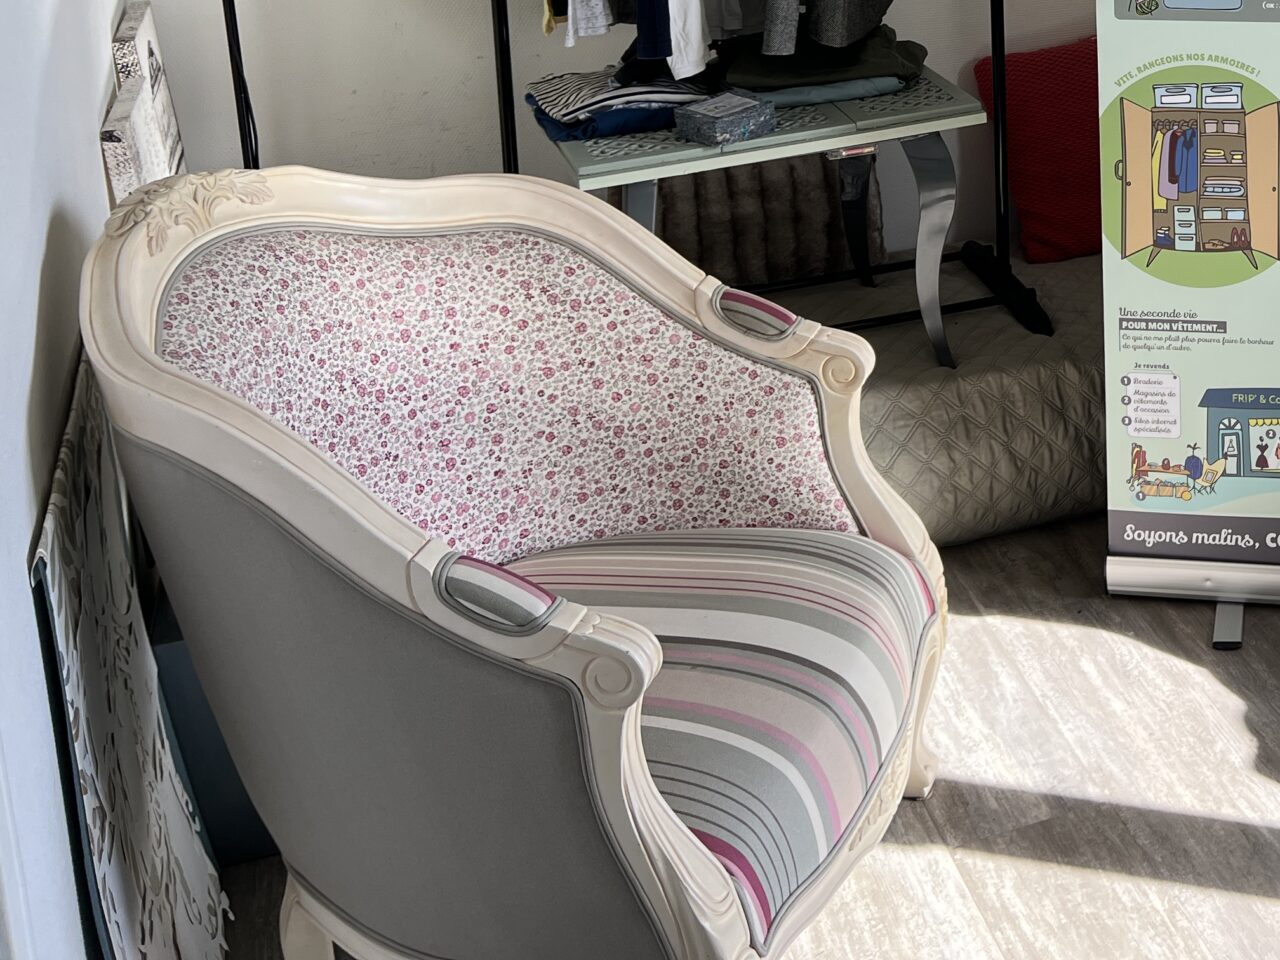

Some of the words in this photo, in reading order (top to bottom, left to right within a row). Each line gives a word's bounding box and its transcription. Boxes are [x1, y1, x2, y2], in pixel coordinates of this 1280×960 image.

[1136, 53, 1184, 75] RANGEONS
[1186, 53, 1205, 62] NOS
[1207, 54, 1256, 76] ARMOIRES
[1119, 307, 1138, 318] Une
[1139, 309, 1182, 318] seconde
[1183, 309, 1198, 318] vie
[1122, 321, 1146, 330] POUR
[1148, 322, 1168, 330] MON
[1170, 321, 1224, 333] VÊTEMENT...
[1259, 395, 1266, 404] &
[1124, 524, 1188, 548] Soyons
[1192, 529, 1260, 548] malins,
